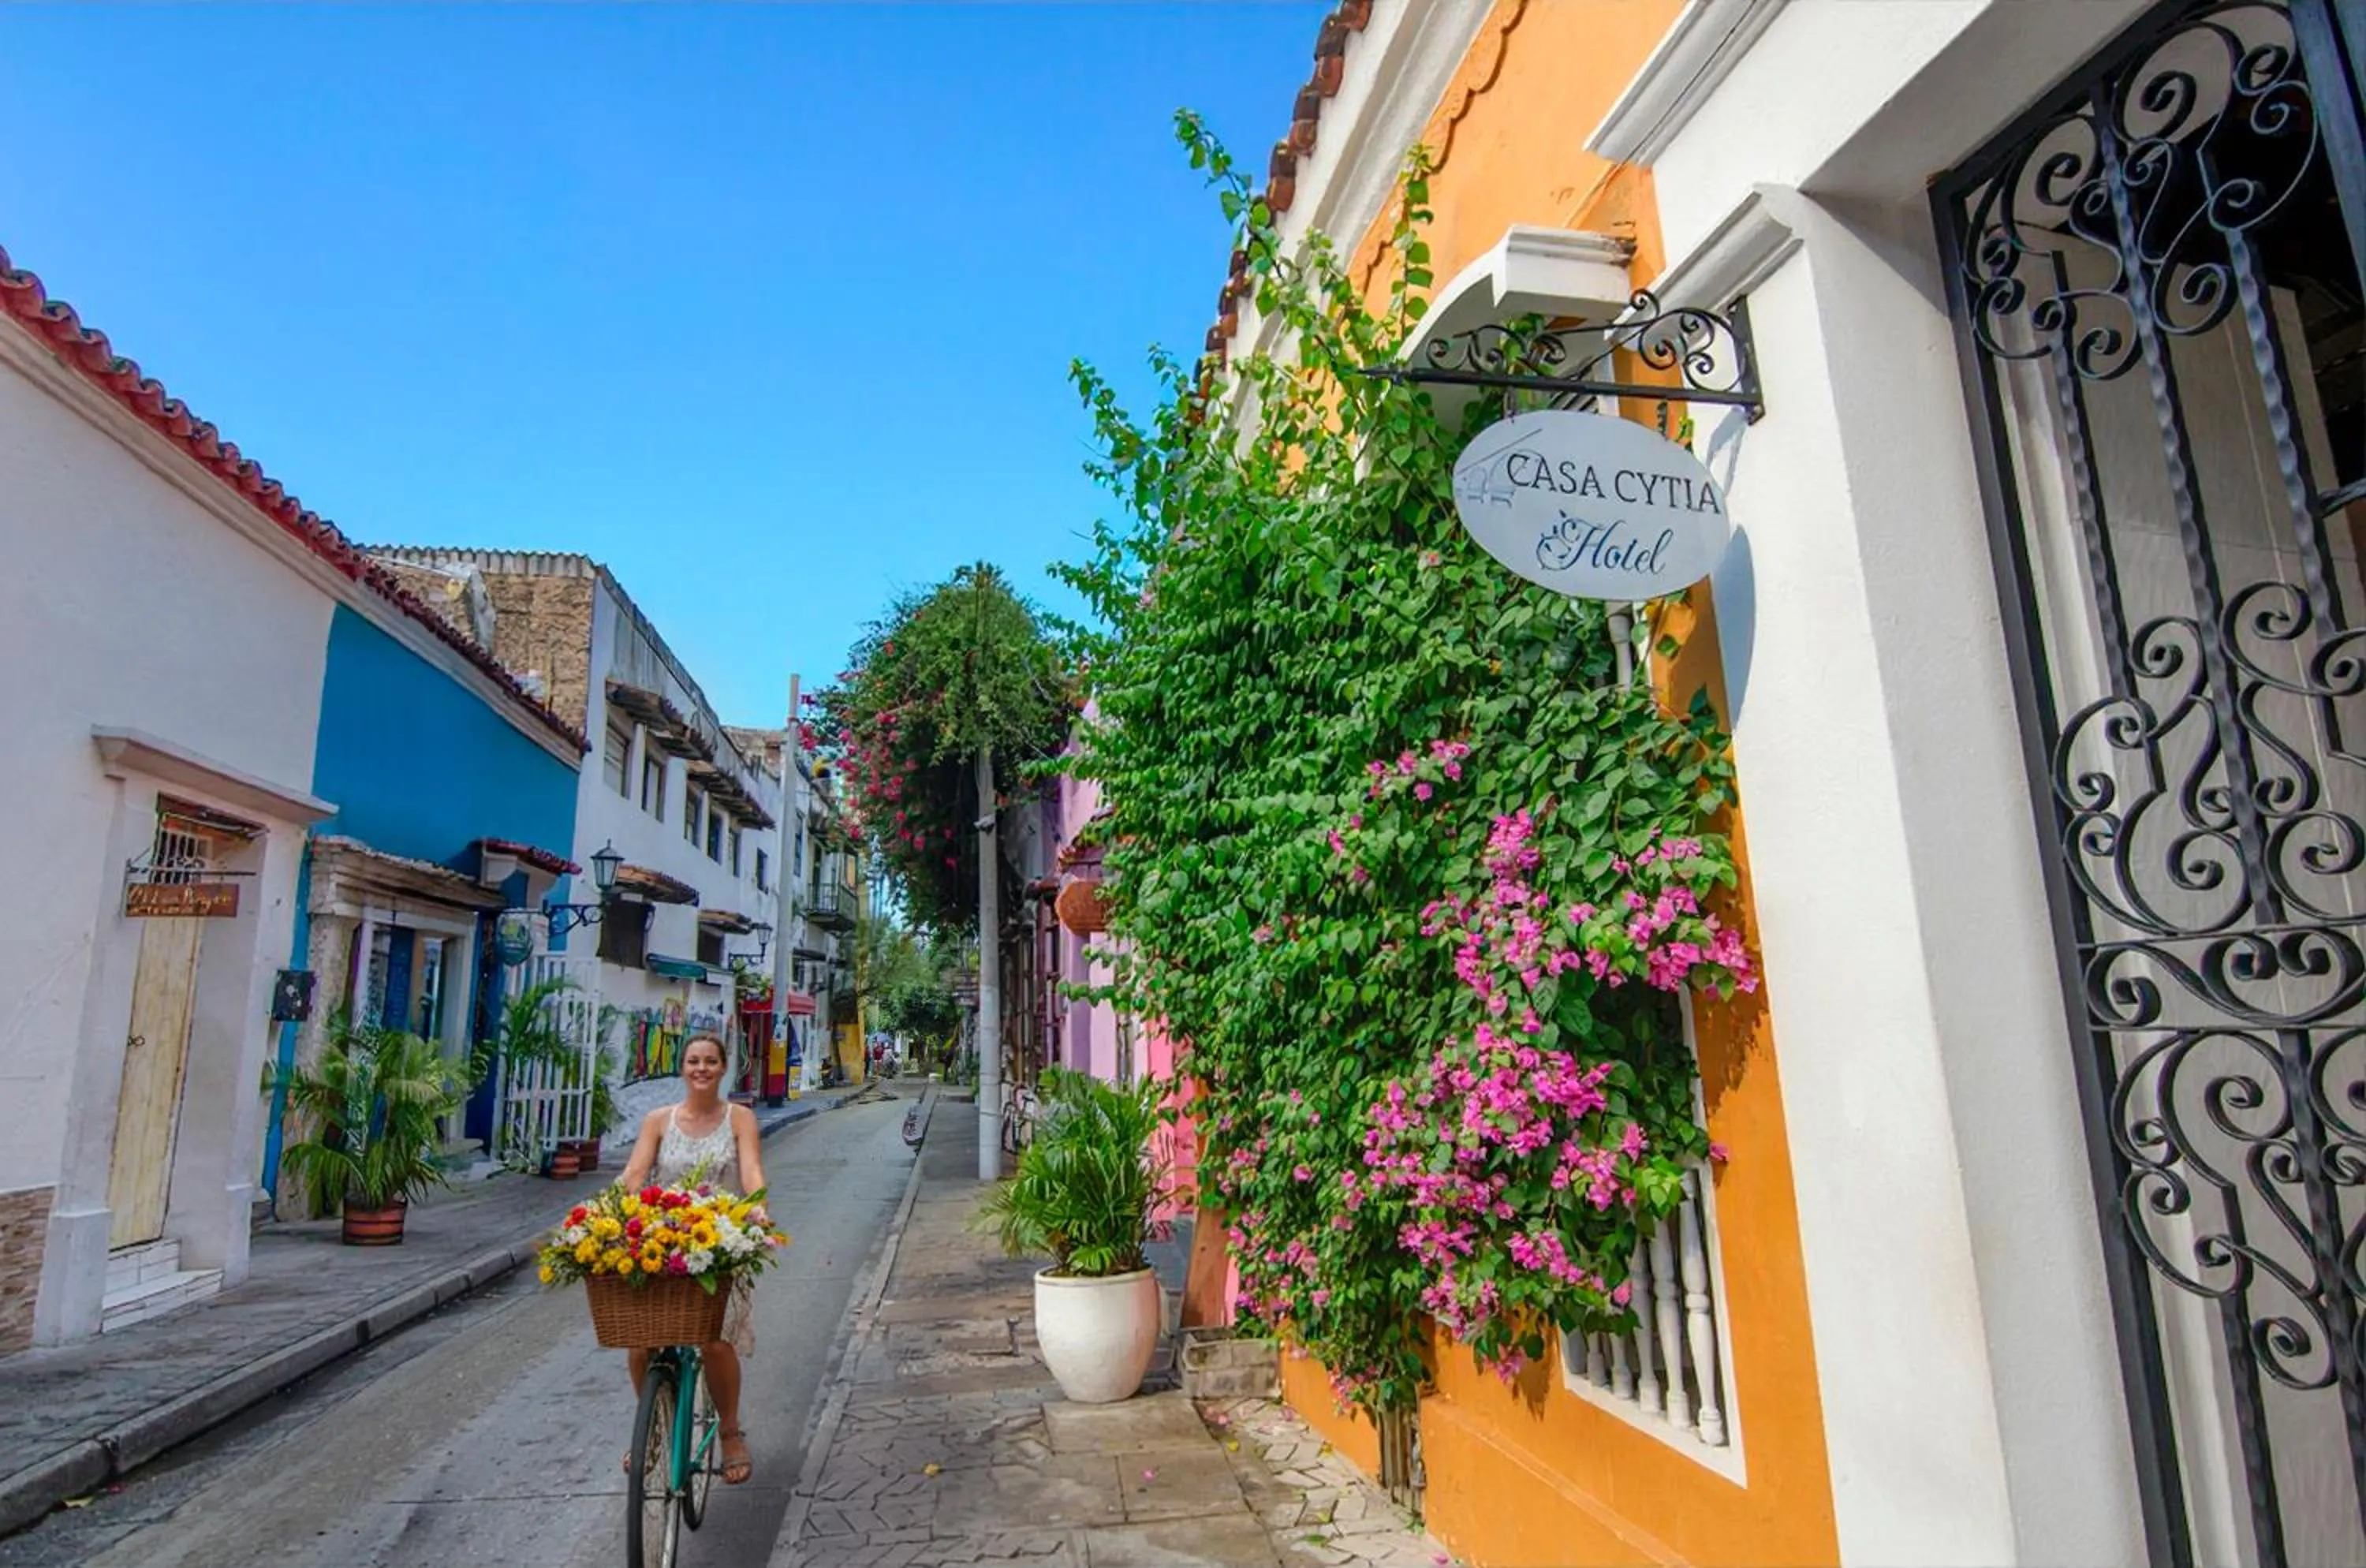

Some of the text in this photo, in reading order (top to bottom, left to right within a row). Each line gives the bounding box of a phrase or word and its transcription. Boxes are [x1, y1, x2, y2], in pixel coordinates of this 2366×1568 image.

[1506, 453, 1722, 513] CASA CYTIA
[1537, 515, 1674, 575] Hotel
